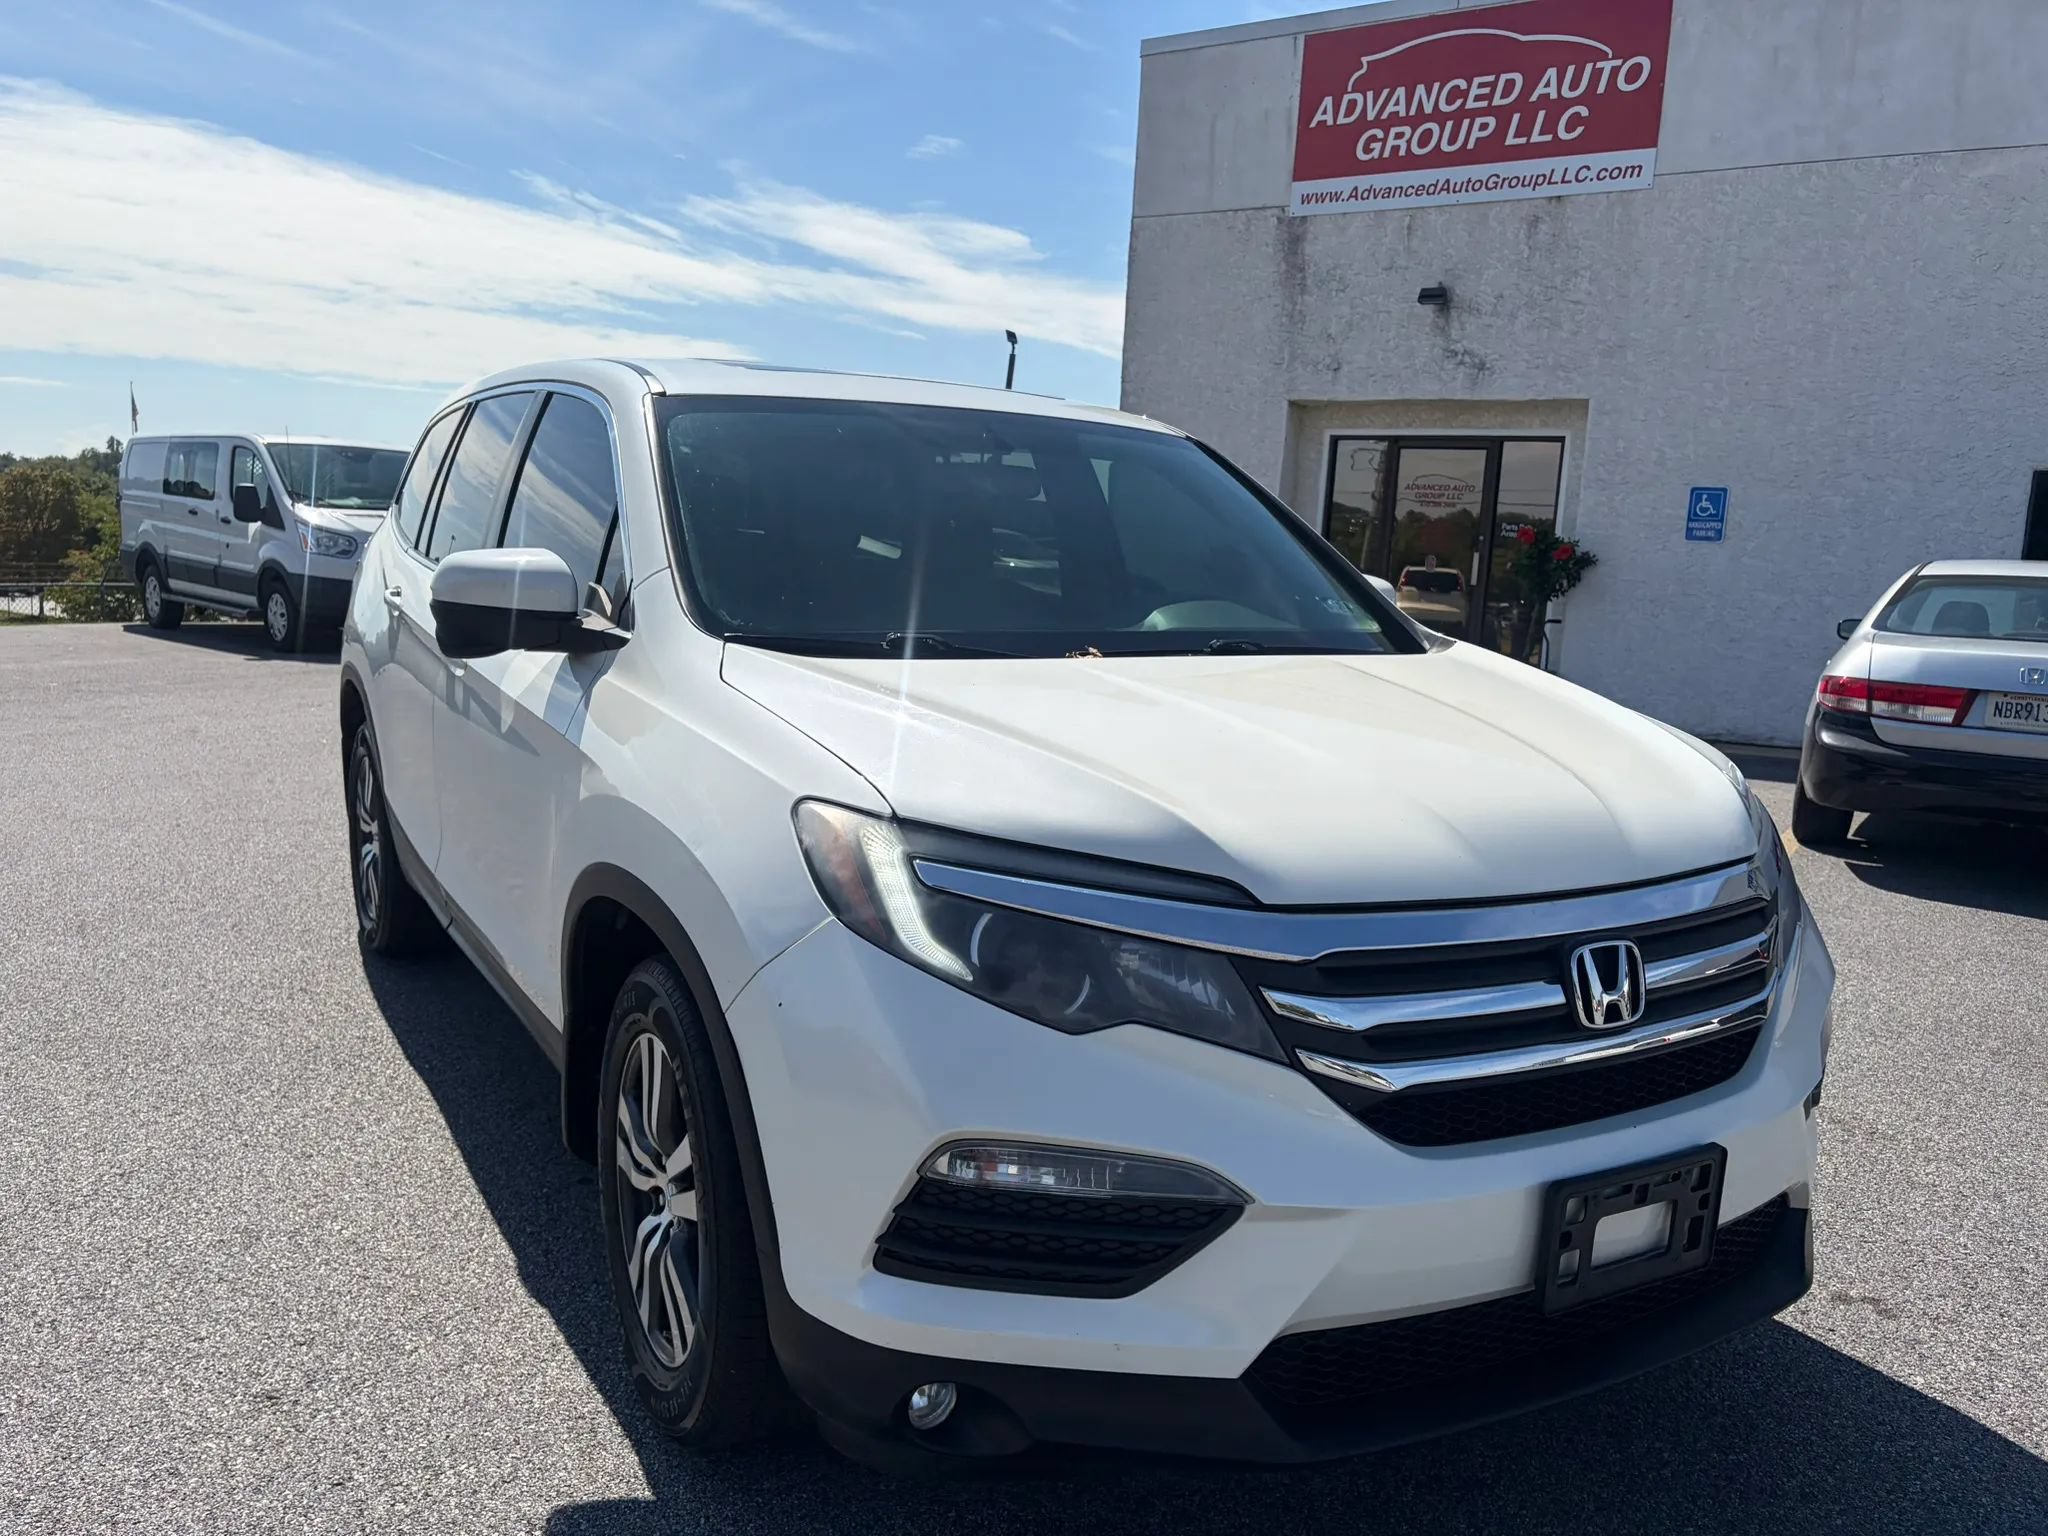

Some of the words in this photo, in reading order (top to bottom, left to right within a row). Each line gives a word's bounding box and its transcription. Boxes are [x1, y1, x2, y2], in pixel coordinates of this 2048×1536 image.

[1309, 72, 1524, 128] ADVANCED
[1529, 56, 1652, 102] AUTO
[1355, 116, 1497, 161] GROUP
[1504, 105, 1590, 146] LLC
[1300, 163, 1644, 206] www.AdvancedAutoGroupLLC.com
[1404, 483, 1451, 492] ADVANCED
[1452, 484, 1476, 493] AUTO
[1414, 492, 1446, 500] GROUP
[1446, 492, 1465, 500] LLC
